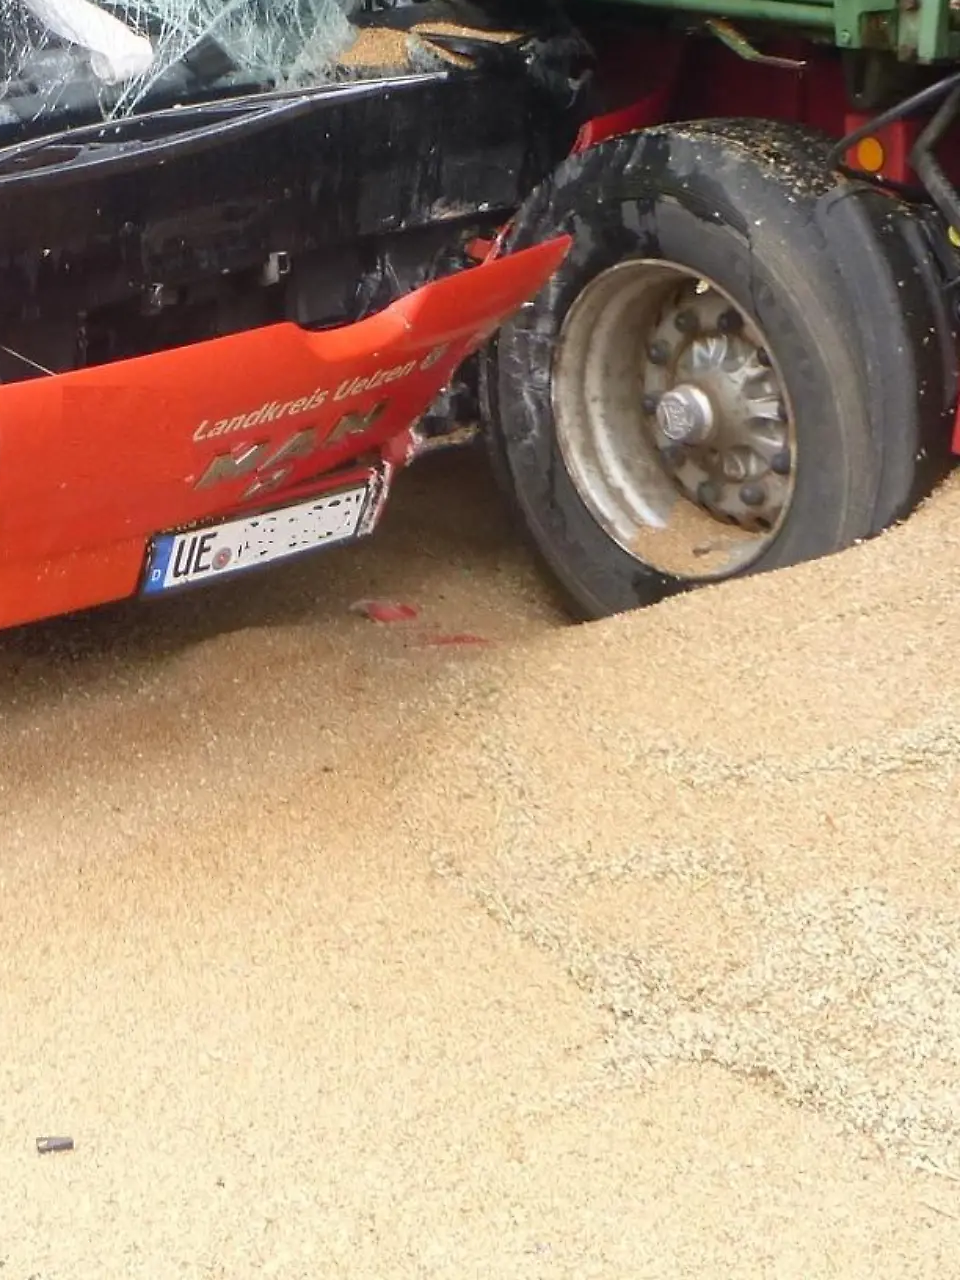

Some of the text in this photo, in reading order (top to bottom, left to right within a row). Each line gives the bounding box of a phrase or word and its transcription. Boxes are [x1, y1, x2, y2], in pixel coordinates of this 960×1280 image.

[193, 359, 416, 442] Landkreis Uelzen
[193, 396, 390, 490] MAN
[151, 531, 219, 581] D UE
